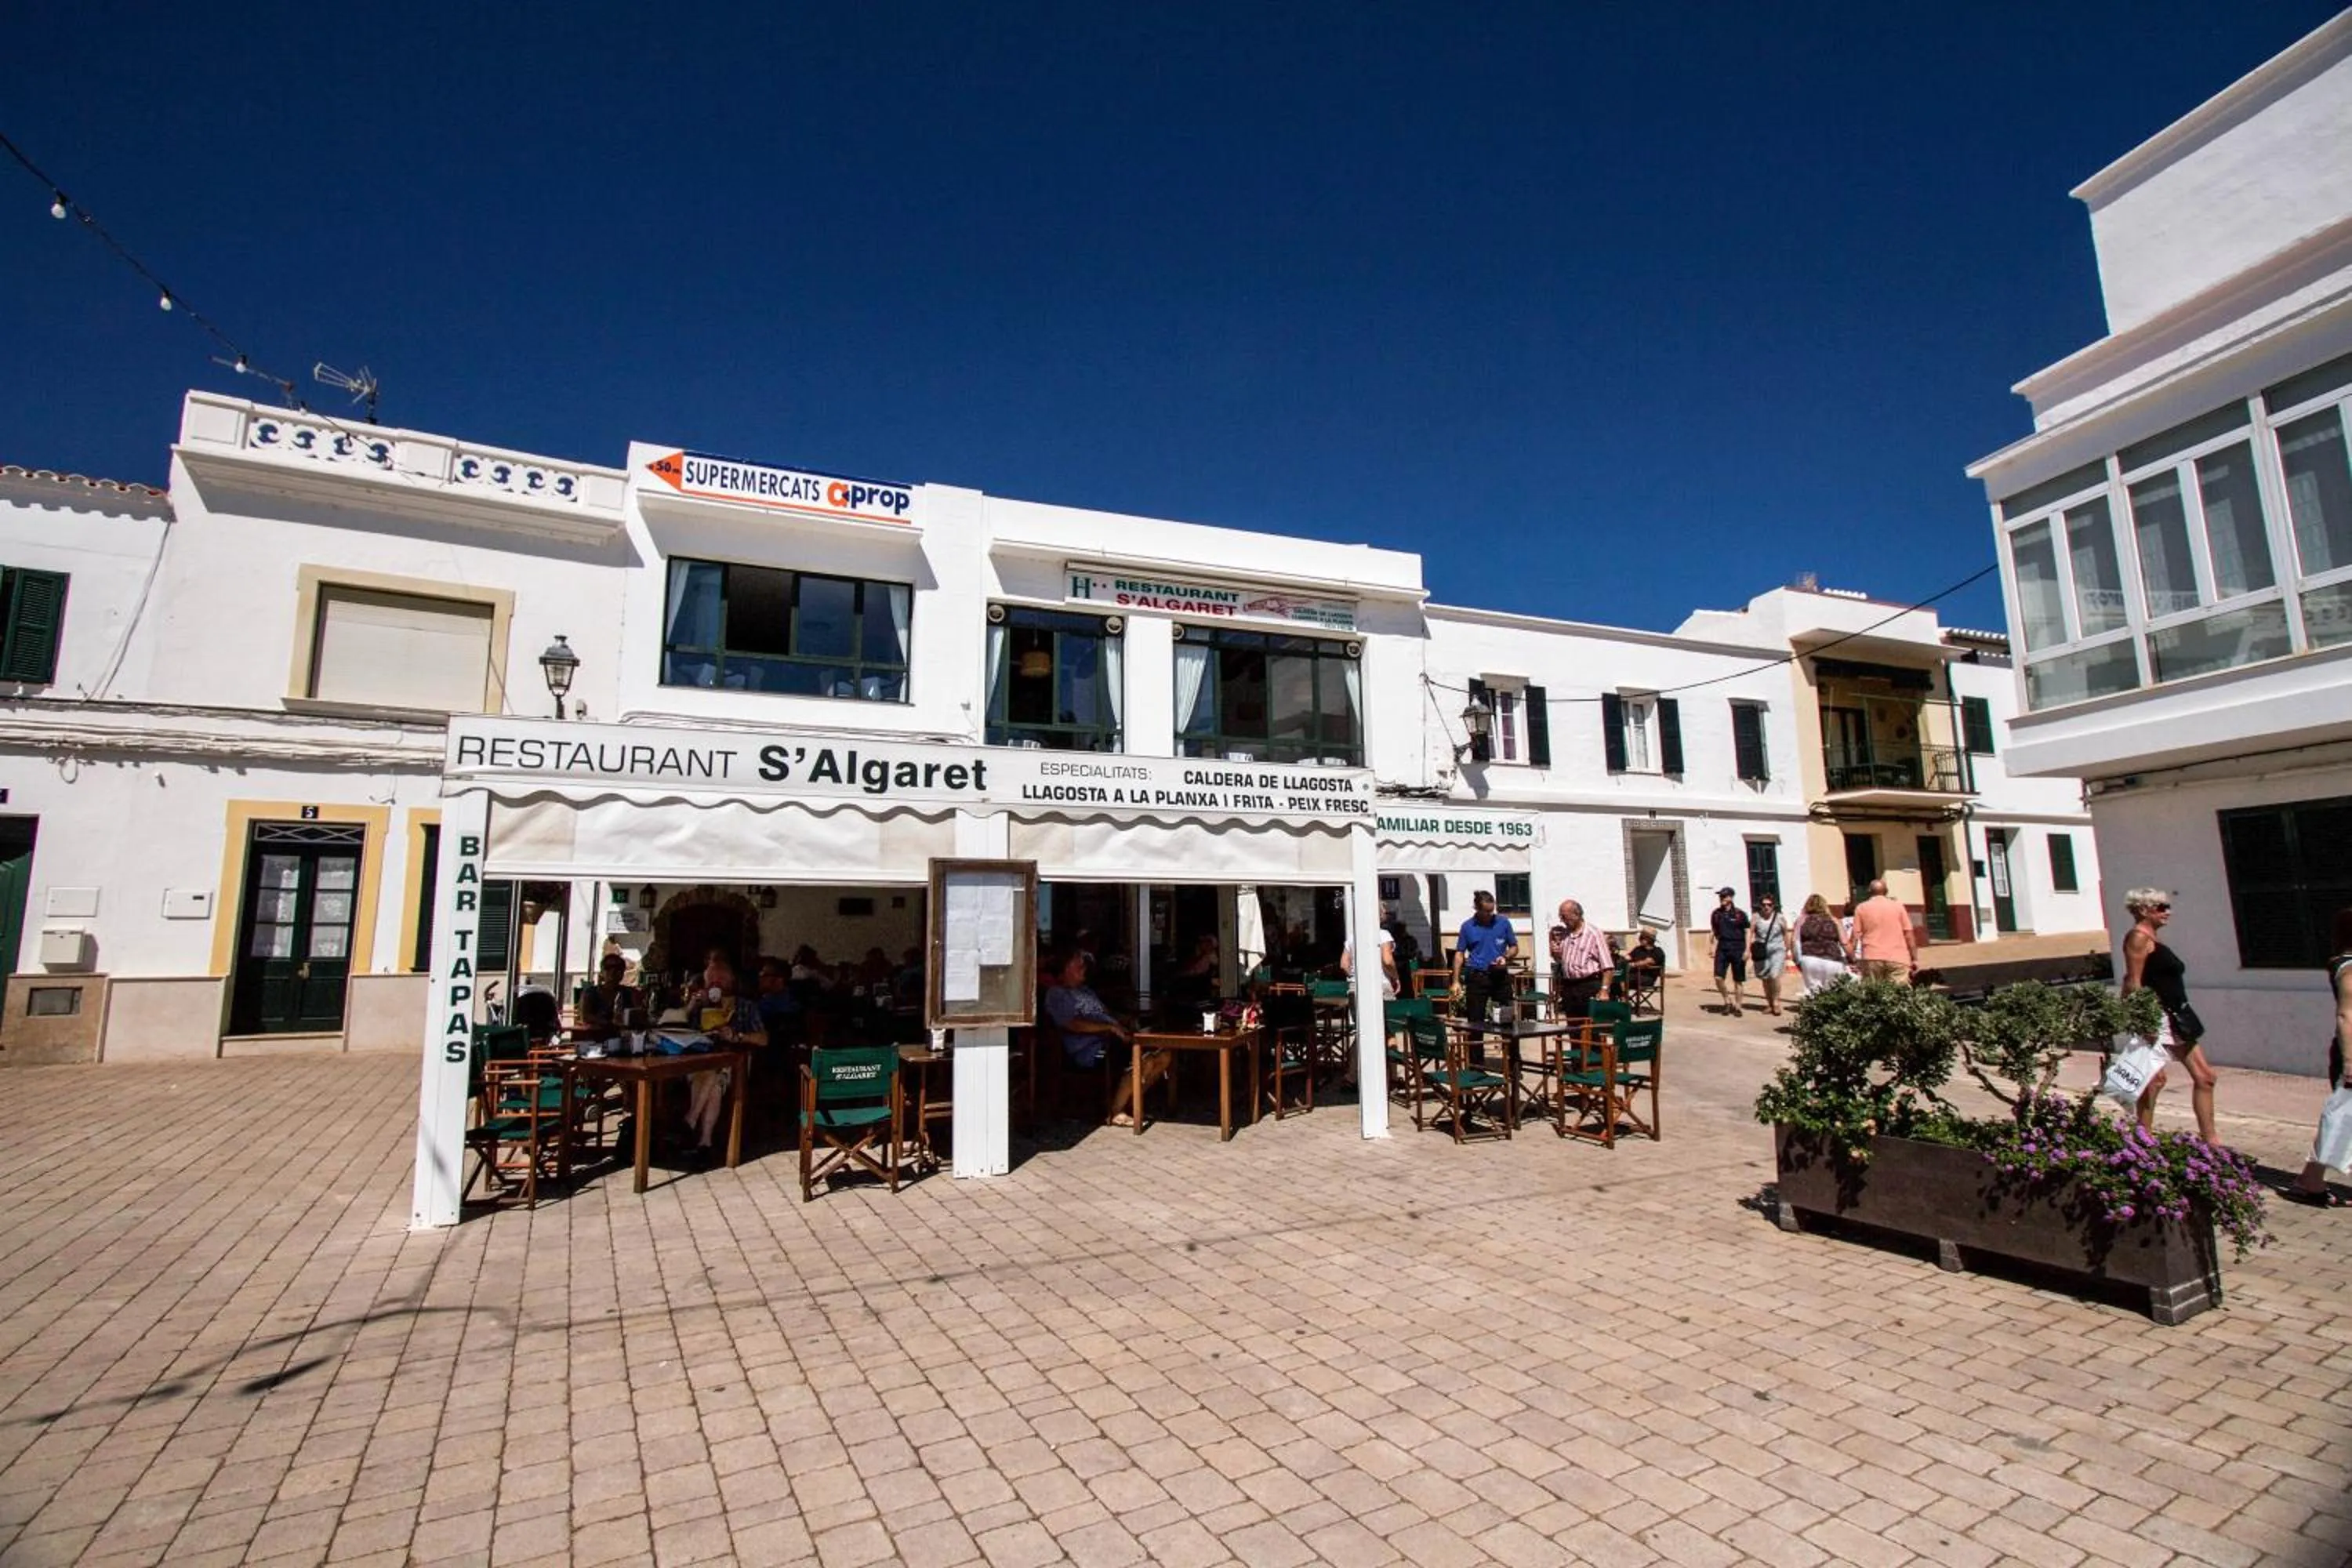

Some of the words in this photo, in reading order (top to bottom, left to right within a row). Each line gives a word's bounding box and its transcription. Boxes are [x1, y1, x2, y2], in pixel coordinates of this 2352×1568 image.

[685, 460, 820, 501] SUPERMERCATS
[1114, 579, 1240, 603] RESTAURANT
[1116, 593, 1237, 616] S'ALGARET
[457, 735, 738, 779] RESTAURANT
[758, 743, 988, 794] S'Algaret
[1040, 761, 1152, 780] ESPECIALITATS:
[1184, 771, 1254, 788] CALDERA
[1259, 775, 1279, 789] DE
[1283, 775, 1354, 793] LLAGOSTA
[1022, 784, 1108, 803] LLAGOSTA
[1113, 789, 1125, 803] A
[1130, 789, 1150, 804] LA
[1156, 790, 1219, 808] PLANXA
[1223, 793, 1229, 808] I
[1233, 794, 1274, 809] FRITA
[1287, 797, 1321, 811] PEIX
[1325, 798, 1369, 813] FRESC
[306, 807, 314, 818] 5
[1377, 816, 1439, 833] AMILIAR
[1445, 820, 1493, 835] DESDE
[1498, 822, 1533, 837] 1963
[456, 836, 480, 912] BAR
[445, 929, 474, 1063] TAPAS
